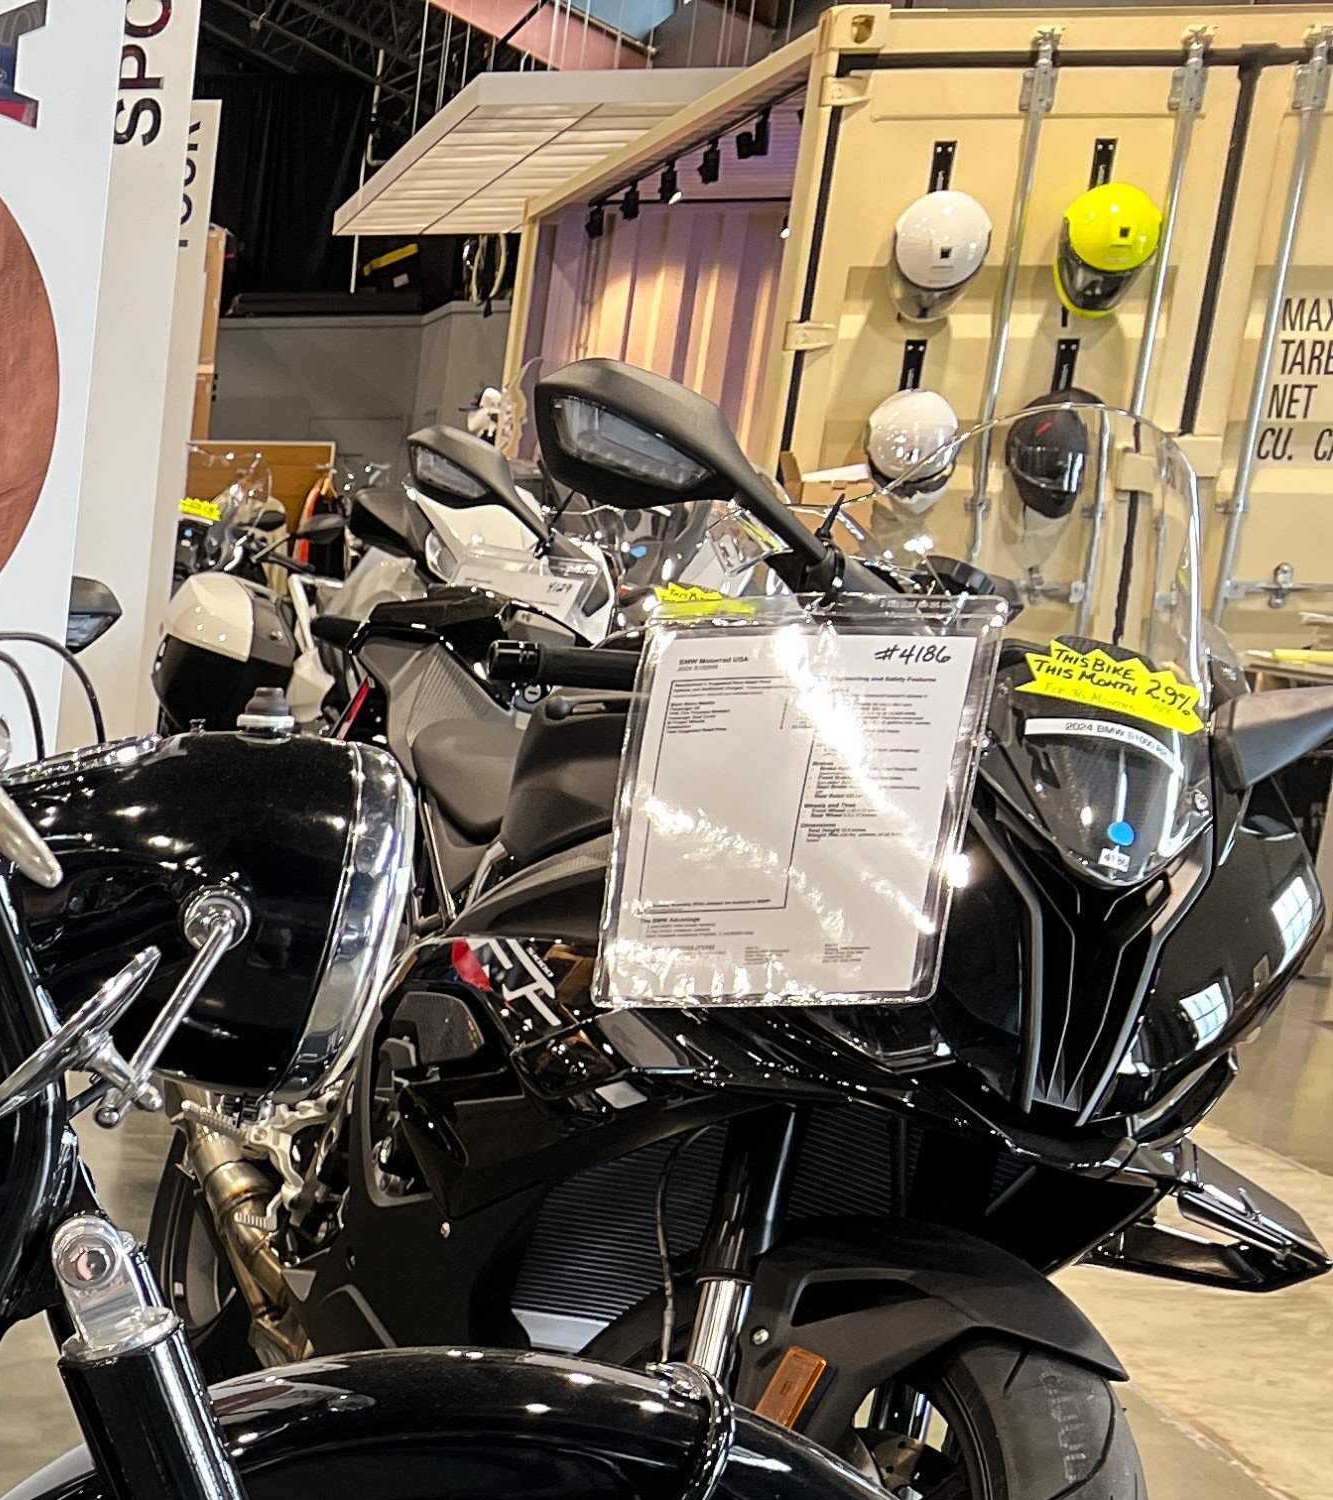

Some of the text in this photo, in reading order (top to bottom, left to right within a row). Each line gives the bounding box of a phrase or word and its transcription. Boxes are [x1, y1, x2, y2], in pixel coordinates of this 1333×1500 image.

[1267, 384, 1318, 419] NET
[1256, 427, 1294, 461] CU.
[873, 644, 953, 666] #4186
[1054, 648, 1137, 681] THIS BIKE
[1033, 659, 1074, 679] THIS
[1144, 679, 1192, 717] 2.9%
[1065, 722, 1093, 731] 2024
[1096, 724, 1125, 737] BMW
